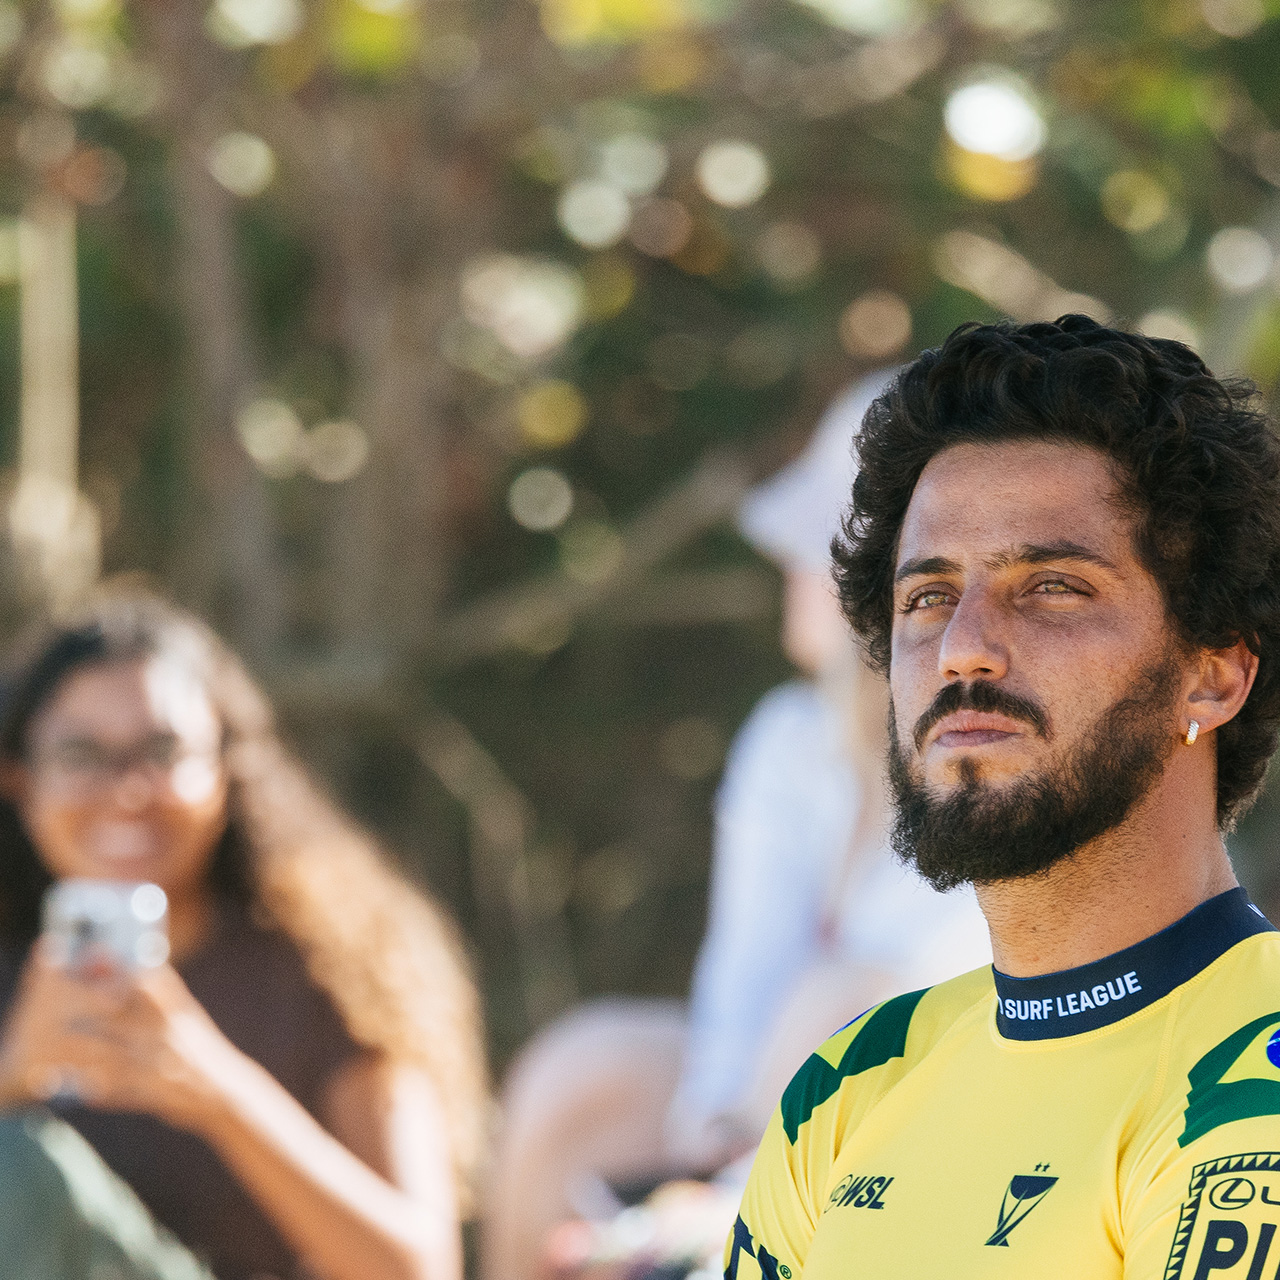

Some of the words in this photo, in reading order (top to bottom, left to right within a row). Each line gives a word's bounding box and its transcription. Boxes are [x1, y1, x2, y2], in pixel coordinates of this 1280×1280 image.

[1005, 998, 1053, 1020] SURF
[1056, 971, 1142, 1017] LEAGUE
[837, 1176, 895, 1210] WSL
